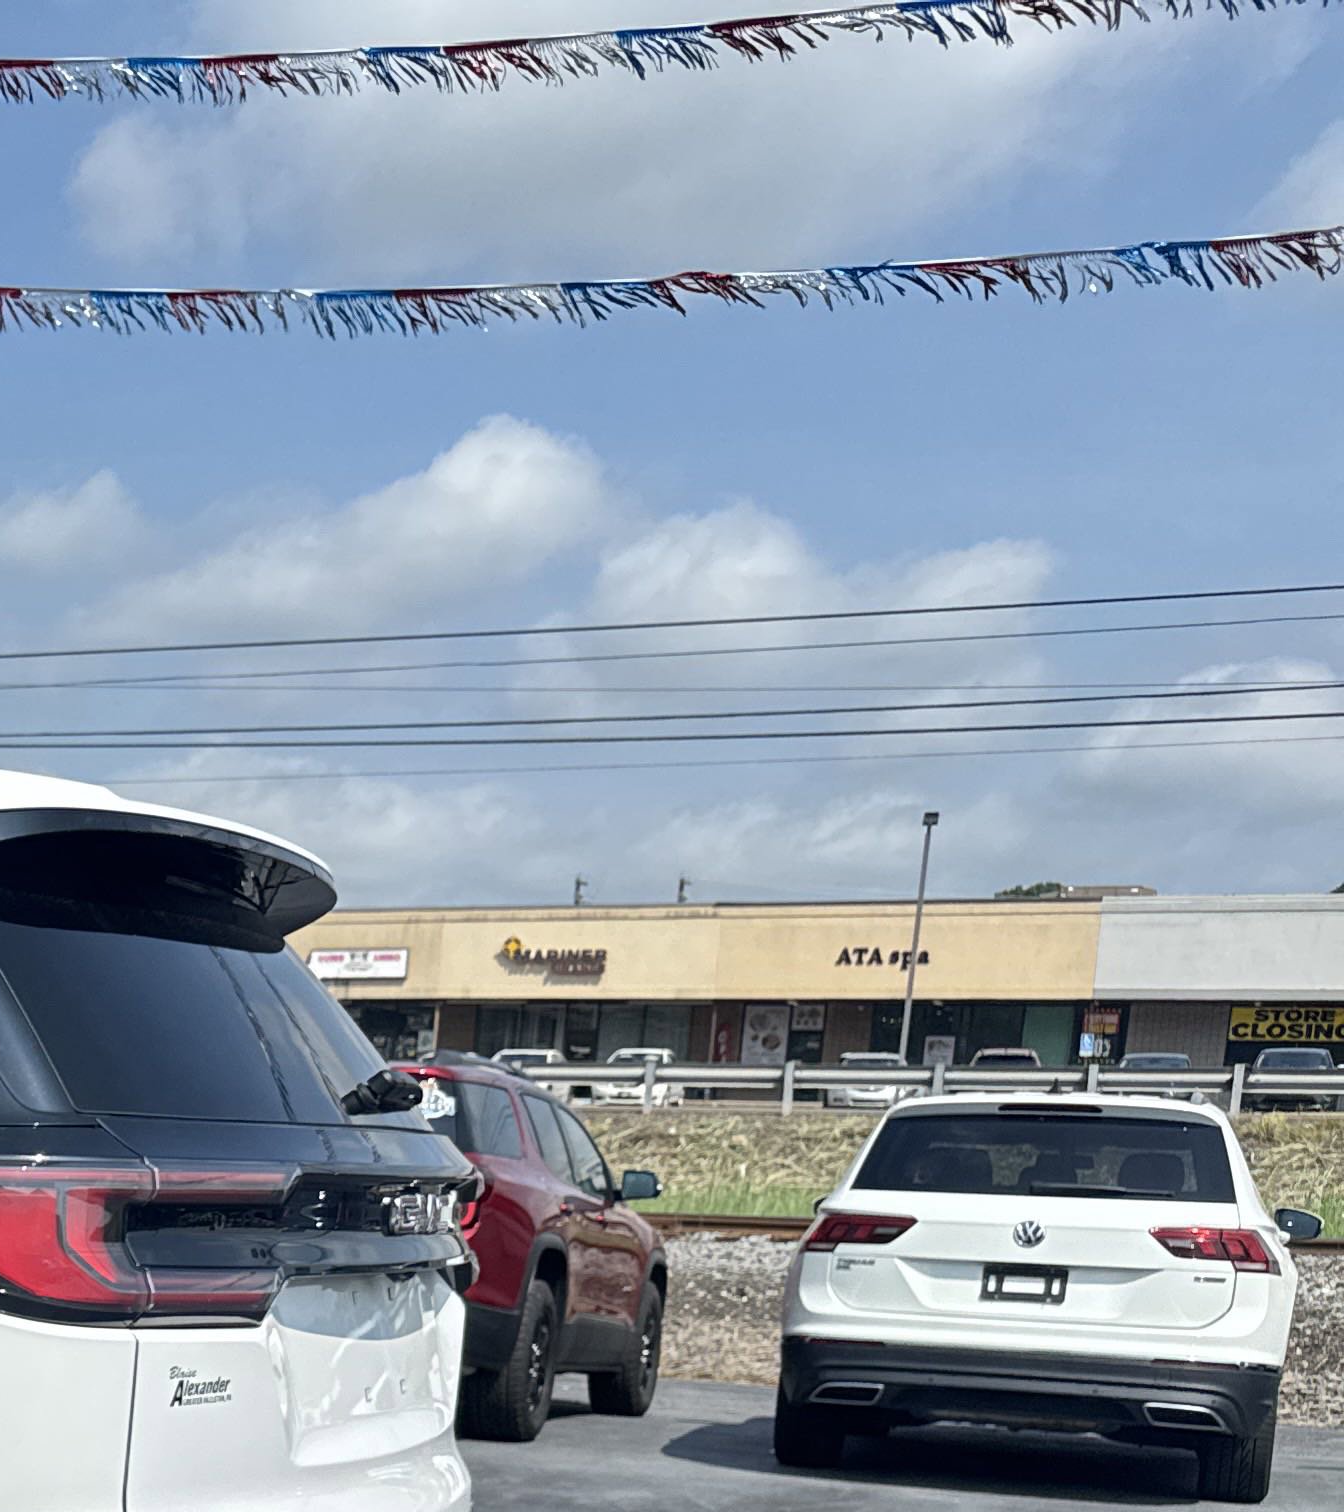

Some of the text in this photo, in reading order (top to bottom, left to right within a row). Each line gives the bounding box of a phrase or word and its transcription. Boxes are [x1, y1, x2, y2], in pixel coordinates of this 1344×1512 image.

[513, 949, 607, 961] MARINER
[834, 946, 929, 972] ATA spa
[1254, 1009, 1336, 1022] STORE
[169, 1366, 198, 1379] Blaise
[169, 1376, 231, 1407] Alexander
